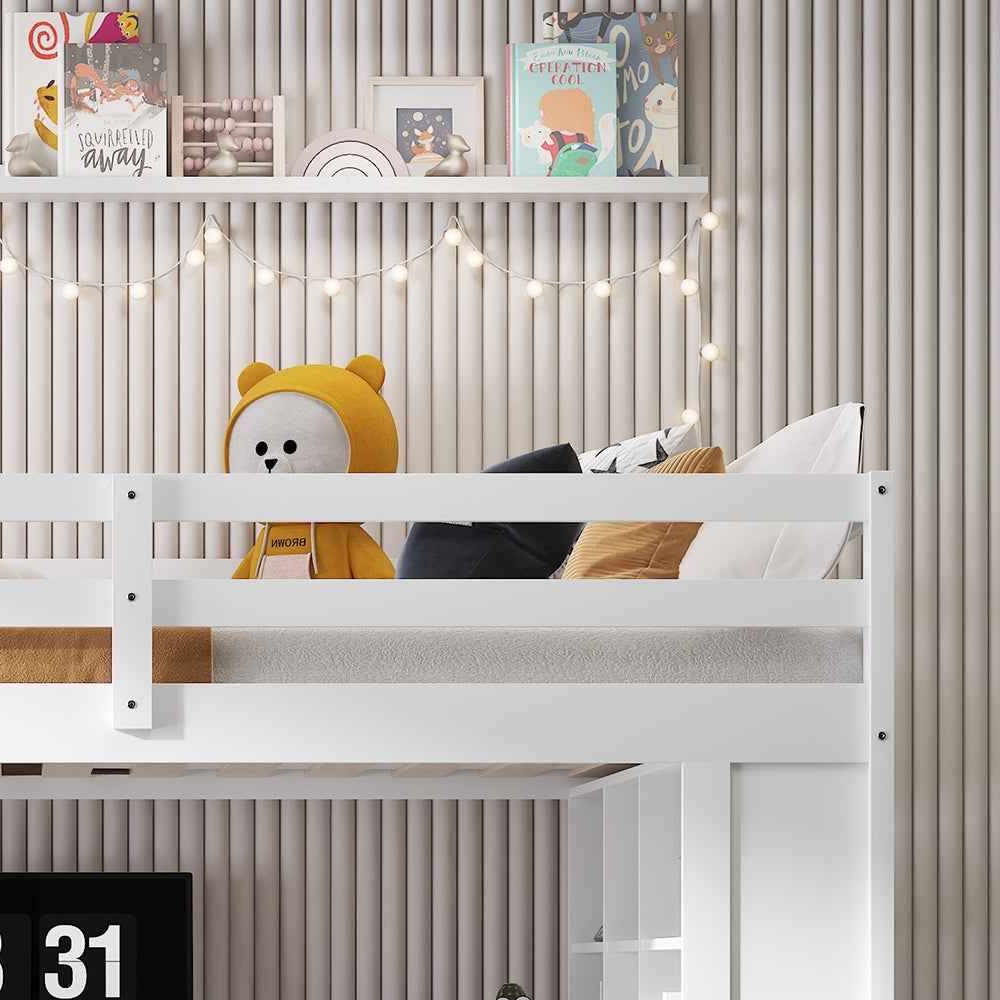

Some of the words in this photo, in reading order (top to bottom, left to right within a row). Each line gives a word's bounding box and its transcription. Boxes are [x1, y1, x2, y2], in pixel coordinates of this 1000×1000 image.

[529, 62, 608, 73] OPERATION
[551, 74, 582, 84] COOL
[81, 147, 152, 177] away
[44, 924, 120, 1000] 31
